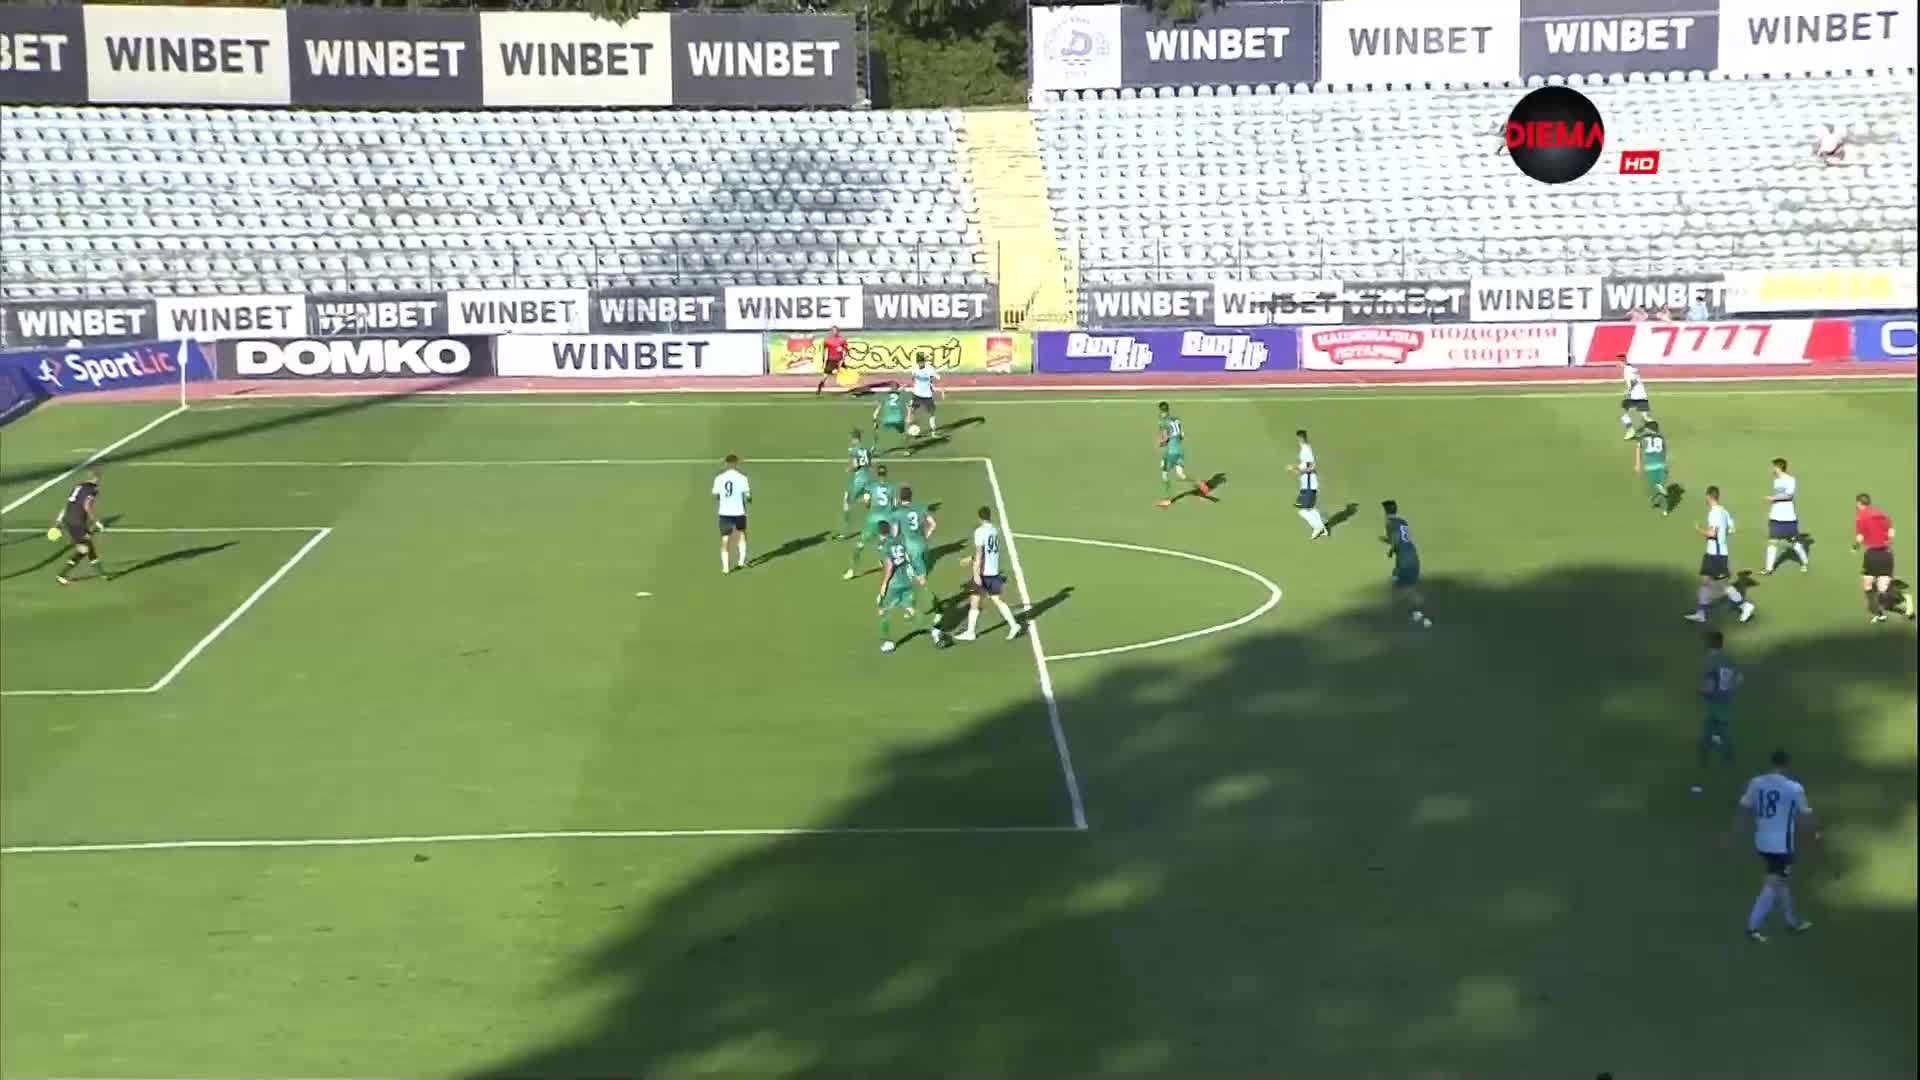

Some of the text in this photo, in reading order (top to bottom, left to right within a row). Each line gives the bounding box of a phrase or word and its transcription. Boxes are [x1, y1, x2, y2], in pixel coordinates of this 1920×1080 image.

[1348, 26, 1493, 57] WINBET
[1545, 17, 1694, 53] WINBET
[1747, 11, 1899, 45] WINBET
[105, 36, 271, 74] WINBET
[304, 39, 466, 77] WINBET
[1145, 26, 1290, 61] WINBET
[500, 42, 653, 76] WINBET
[687, 41, 840, 77] WINBET
[599, 296, 715, 323] WINBET
[737, 297, 850, 319] WINBET
[873, 292, 988, 320] WINBET
[1093, 289, 1210, 318] WINBET
[1478, 287, 1593, 312] WINBET
[1606, 281, 1727, 310] WINBET
[18, 308, 146, 337] WINBET
[171, 305, 292, 333] WINBET
[316, 301, 438, 330] WINBET
[460, 301, 576, 324] WINBET
[1651, 324, 1772, 356] 7777
[64, 349, 175, 387] SportLic
[236, 339, 471, 375] DOMKO
[552, 341, 709, 370] WINBET
[889, 392, 899, 406] 2
[1644, 436, 1663, 452] 18
[724, 481, 733, 497] 9
[876, 487, 889, 506] 5
[907, 512, 919, 531] 3
[1758, 789, 1779, 818] 18
